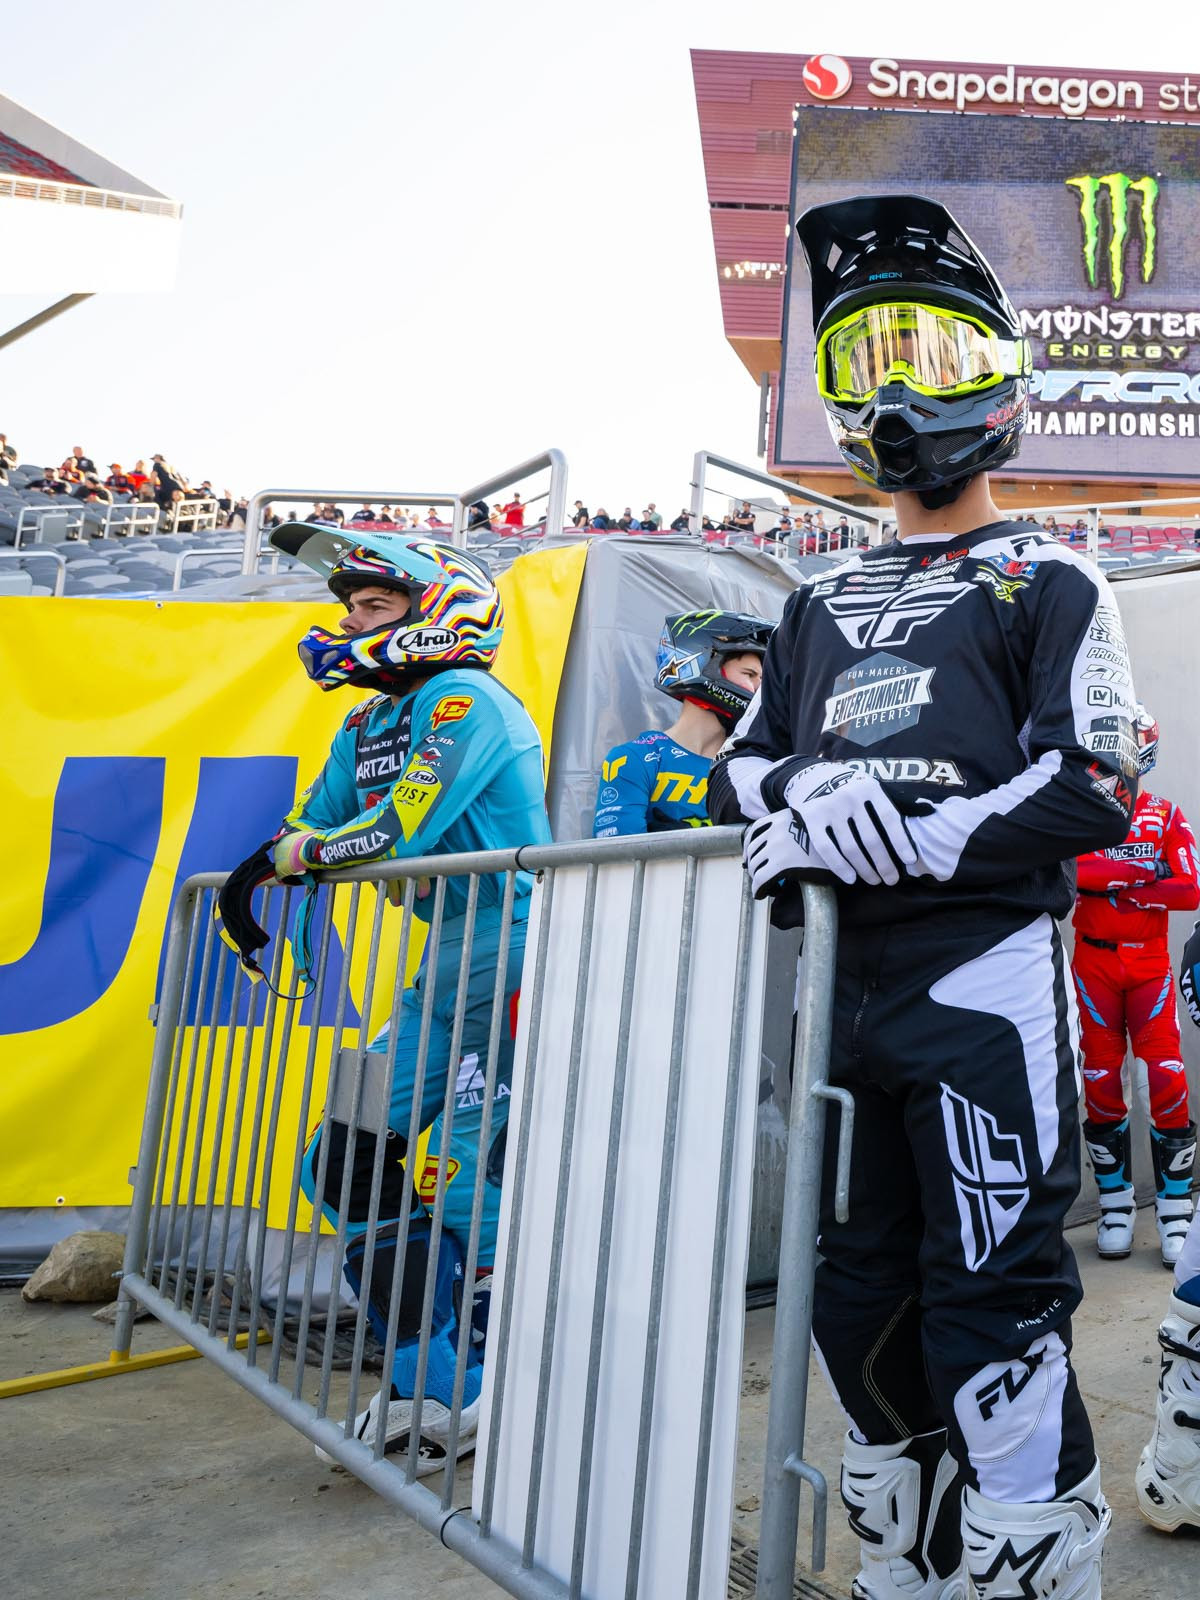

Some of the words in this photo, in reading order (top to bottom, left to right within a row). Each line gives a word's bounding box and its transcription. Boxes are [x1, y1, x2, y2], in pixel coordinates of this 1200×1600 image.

[867, 58, 1145, 116] Snapdragon
[868, 271, 903, 282] RHEON
[1048, 343, 1186, 359] ENERGY
[903, 560, 964, 584] SHOWA
[402, 630, 454, 648] Arai
[847, 665, 908, 680] FUN-MAKERS
[831, 676, 921, 726] ENTERTAINMENT
[855, 706, 912, 728] EXPERTS
[394, 786, 429, 804] FIST
[1092, 782, 1130, 820] PROPANE
[327, 831, 391, 862] PARTZILLA
[1108, 845, 1153, 860] Muc-Off
[1016, 1298, 1062, 1330] KINETIC
